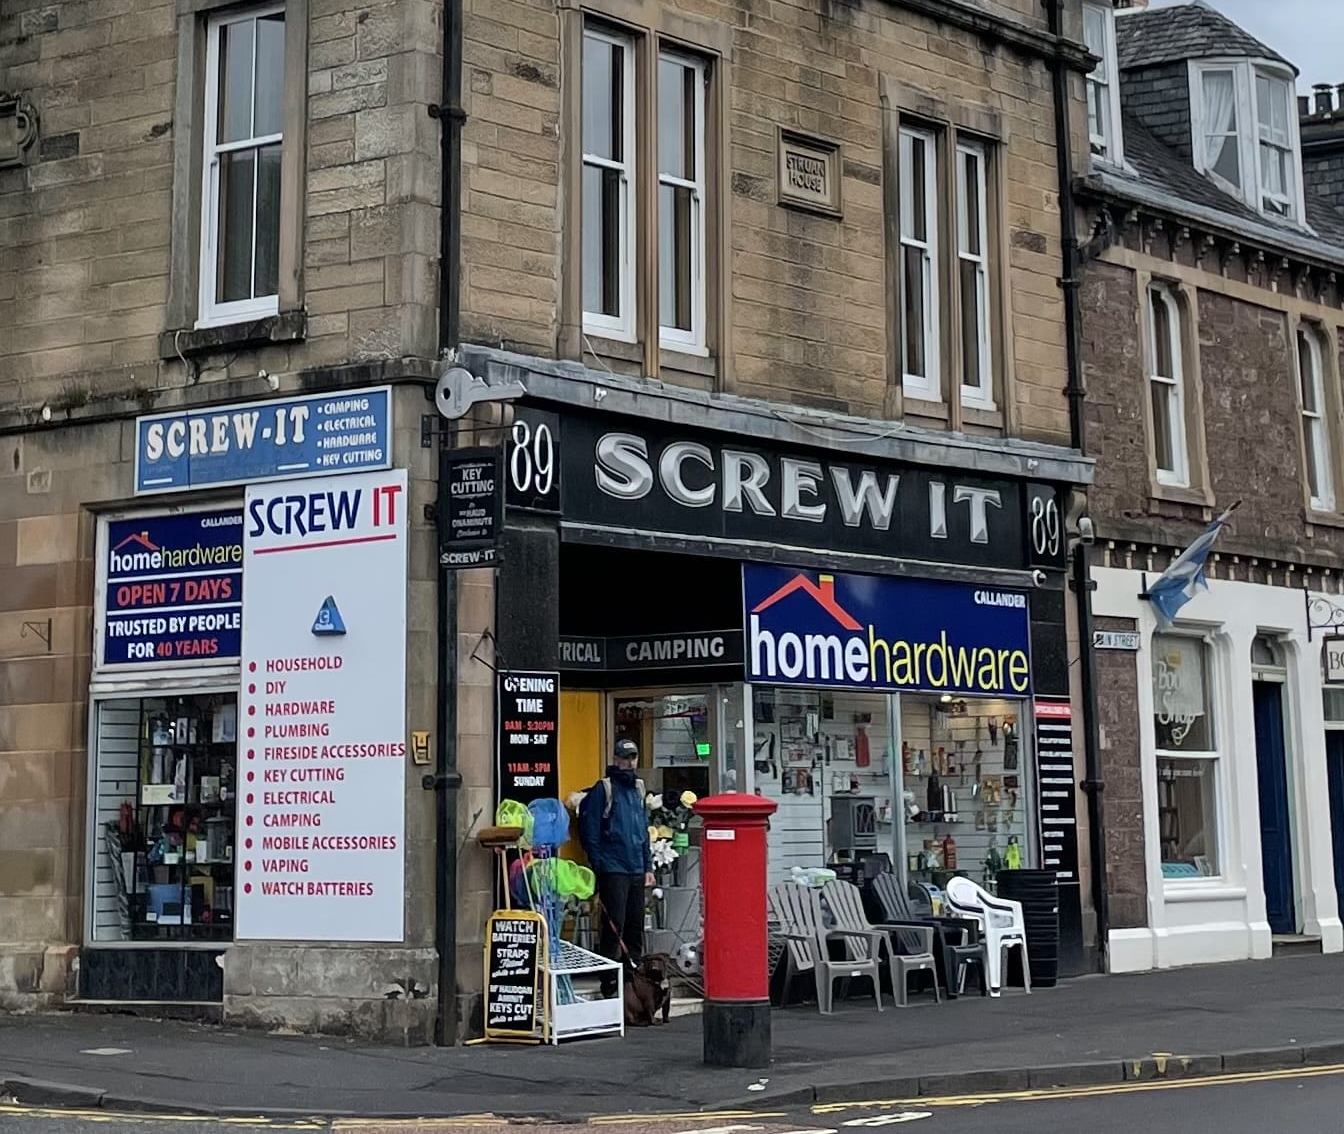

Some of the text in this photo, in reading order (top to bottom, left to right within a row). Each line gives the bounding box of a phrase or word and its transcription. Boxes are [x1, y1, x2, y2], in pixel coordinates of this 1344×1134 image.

[787, 155, 825, 177] STRUAN
[789, 169, 822, 193] HOUSE
[324, 398, 370, 415] CAMPING
[323, 414, 377, 432] ELECTRICAL
[146, 405, 310, 461] SCREW-IT
[323, 432, 377, 449] HARDWARE
[322, 448, 383, 466] KEY CUTTING
[510, 420, 554, 495] 89
[462, 467, 483, 481] KEY
[450, 479, 495, 495] CUTTING
[594, 432, 1003, 545] SCREW IT
[249, 485, 402, 538] SCREW IT
[201, 515, 243, 528] CALLANDER
[1032, 496, 1060, 556] 89
[440, 549, 496, 565] SCREW-IT
[117, 577, 233, 607] OPEN 7 DAYS
[973, 590, 1026, 608] CALLANDER
[107, 612, 242, 638] TRUSTED BY PEOPLE
[127, 638, 219, 659] FOR 40 YEARS
[1115, 634, 1138, 647] STREET
[625, 637, 725, 662] CAMPING
[266, 656, 343, 673] HOUSEHOLD
[265, 680, 287, 695] DIY
[504, 676, 555, 693] OPENING
[265, 700, 336, 717] HARDWARE
[515, 698, 544, 714] TIME
[264, 723, 330, 739] PLUMBING
[264, 743, 406, 761] FIRESIDE ACCESSORIES
[264, 767, 345, 783] KEY CUTTING
[507, 762, 529, 773] 11AM
[513, 775, 546, 787] SUNDAY
[263, 790, 336, 805] ELECTRICAL
[263, 813, 322, 827] CAMPING
[262, 835, 397, 851] MOBILE ACCESSORIES
[262, 859, 309, 873] VAPING
[261, 881, 374, 896] WATCH BATTERIES
[495, 920, 534, 933] WATCH
[492, 932, 537, 944] BATTERIES
[496, 948, 530, 959] STRAPS
[489, 1002, 533, 1014] KEYS CUT
